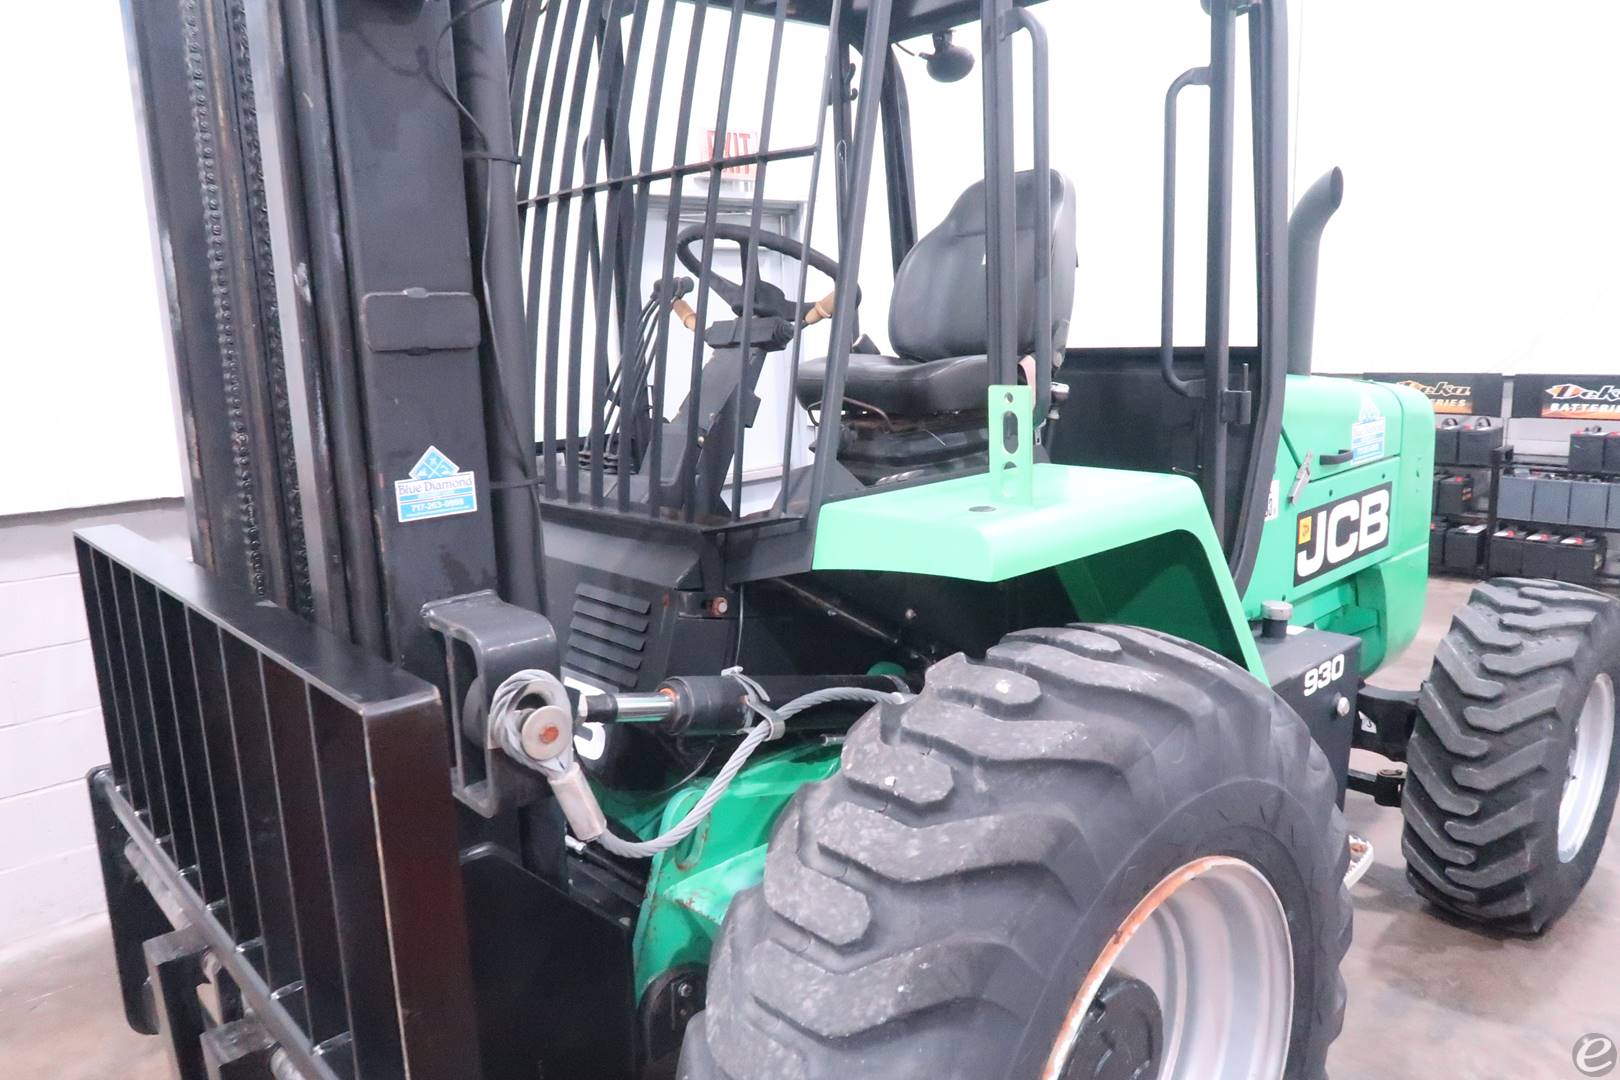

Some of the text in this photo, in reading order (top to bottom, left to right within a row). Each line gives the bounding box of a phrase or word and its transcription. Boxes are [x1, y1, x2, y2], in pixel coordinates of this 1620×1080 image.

[398, 484, 422, 495] Blue
[424, 477, 473, 491] Diamond
[1296, 489, 1390, 577] JCB
[1303, 653, 1345, 697] 930
